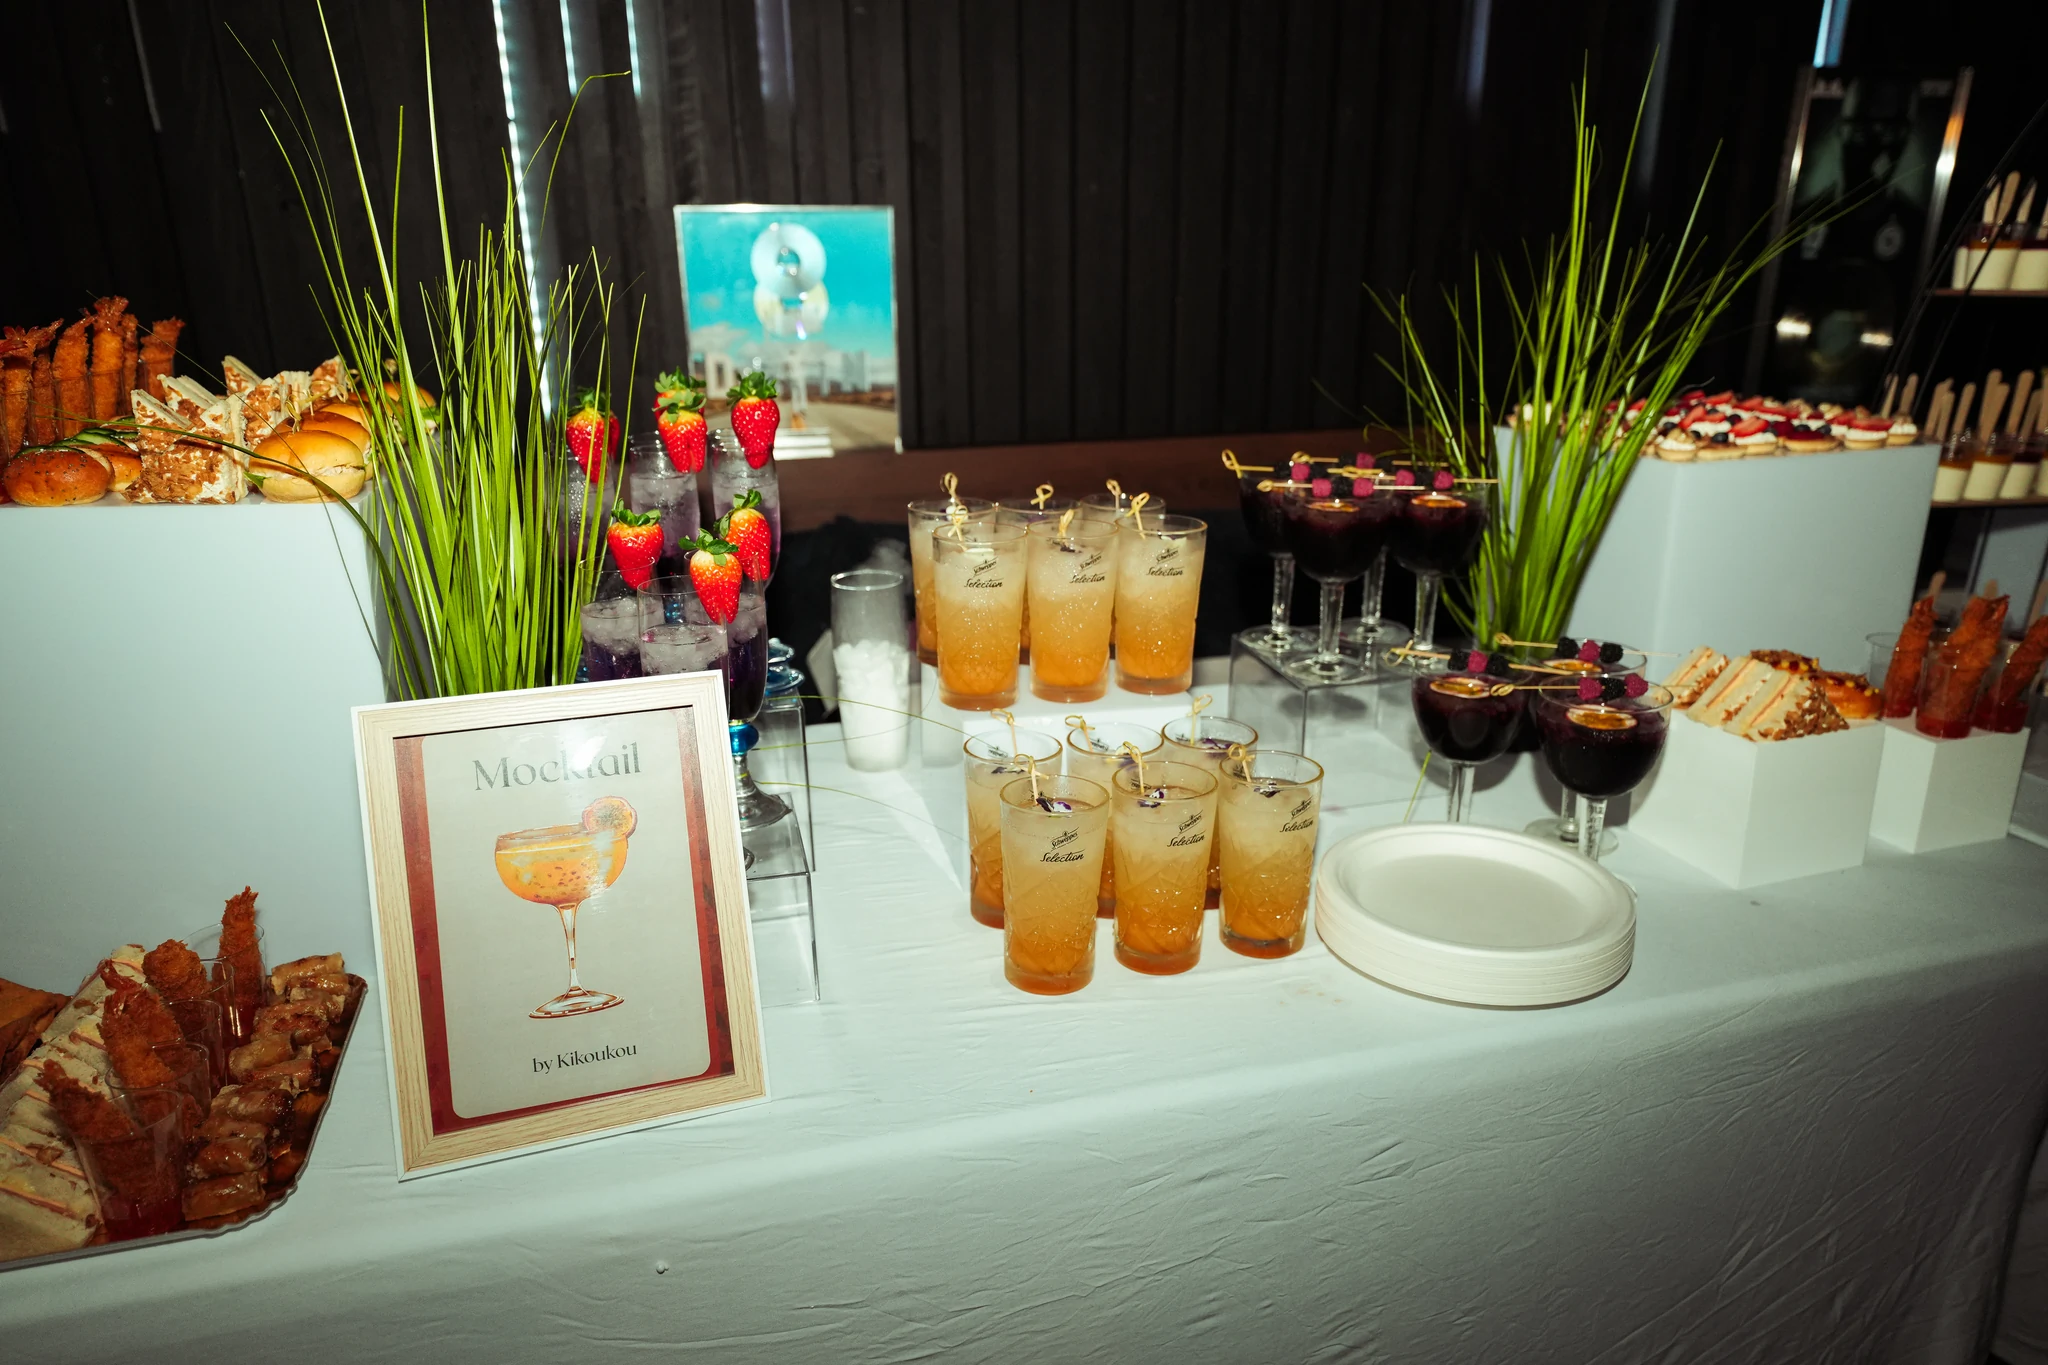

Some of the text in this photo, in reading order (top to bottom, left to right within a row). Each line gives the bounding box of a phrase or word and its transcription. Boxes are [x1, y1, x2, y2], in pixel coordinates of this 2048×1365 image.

[1069, 573, 1106, 584] Selection
[1146, 566, 1183, 577] Selection
[964, 578, 1003, 588] Selection
[1279, 818, 1314, 833] Selection
[1166, 830, 1206, 848] Selection
[1040, 849, 1085, 863] Selection
[532, 1044, 637, 1075] by Kikoukou
